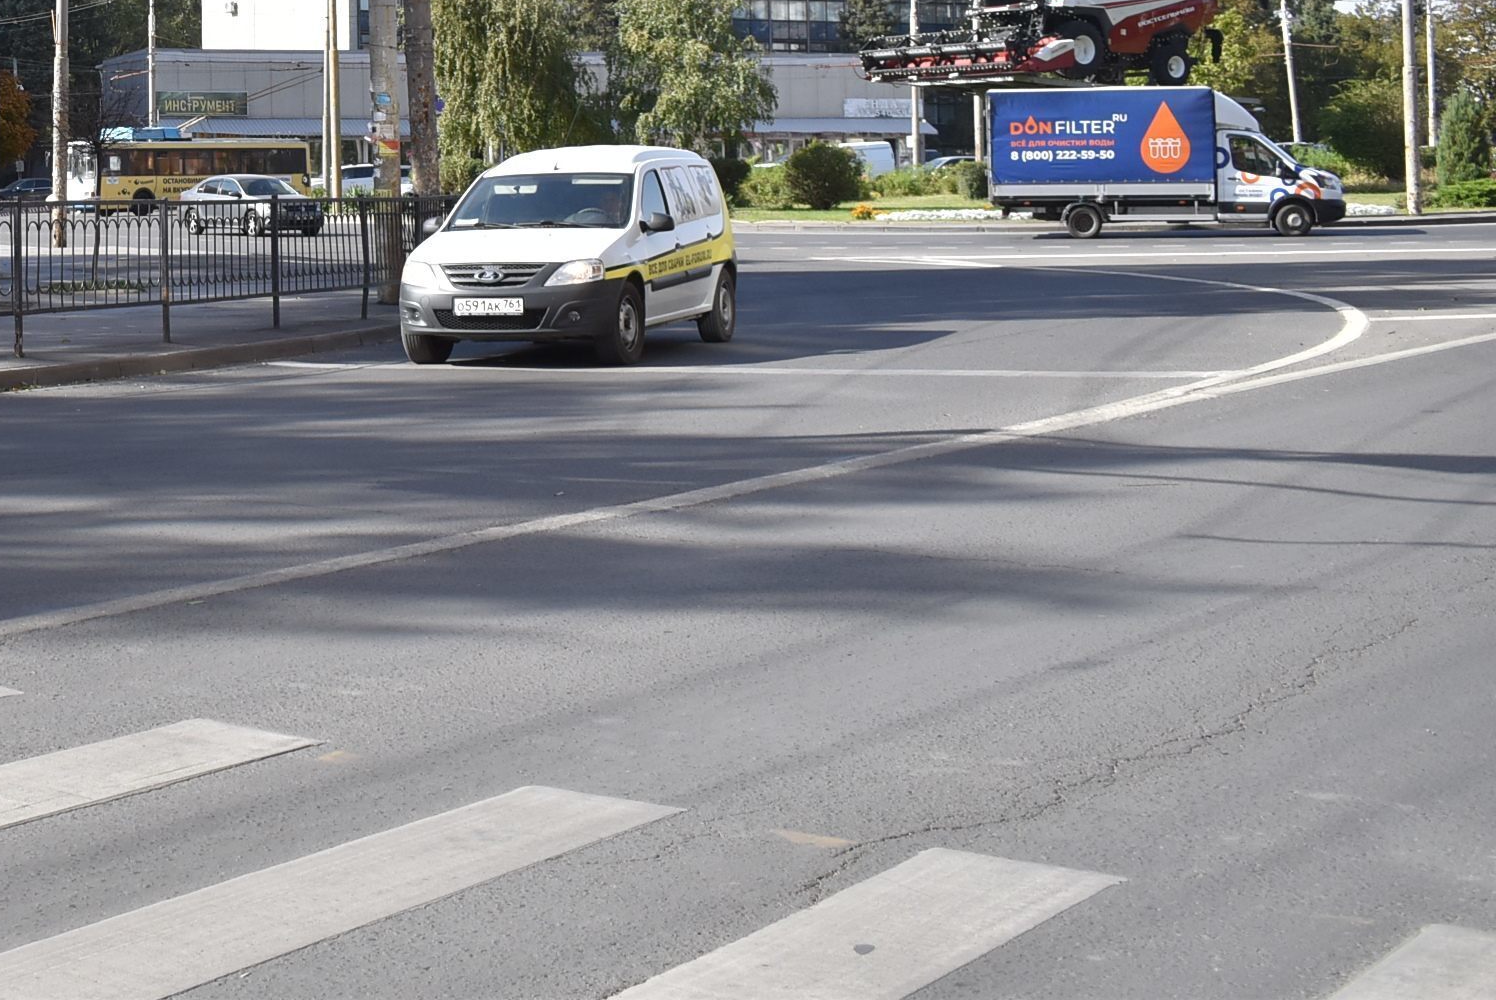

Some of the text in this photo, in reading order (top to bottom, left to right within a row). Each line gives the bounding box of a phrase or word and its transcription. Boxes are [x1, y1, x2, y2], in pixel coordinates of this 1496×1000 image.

[1028, 140, 1046, 148] ДЛЯ
[1047, 139, 1087, 147] ОЧИСТКИ
[1089, 139, 1115, 147] ВОДЫ
[1010, 149, 1115, 162] 8 (800) 222-59-50
